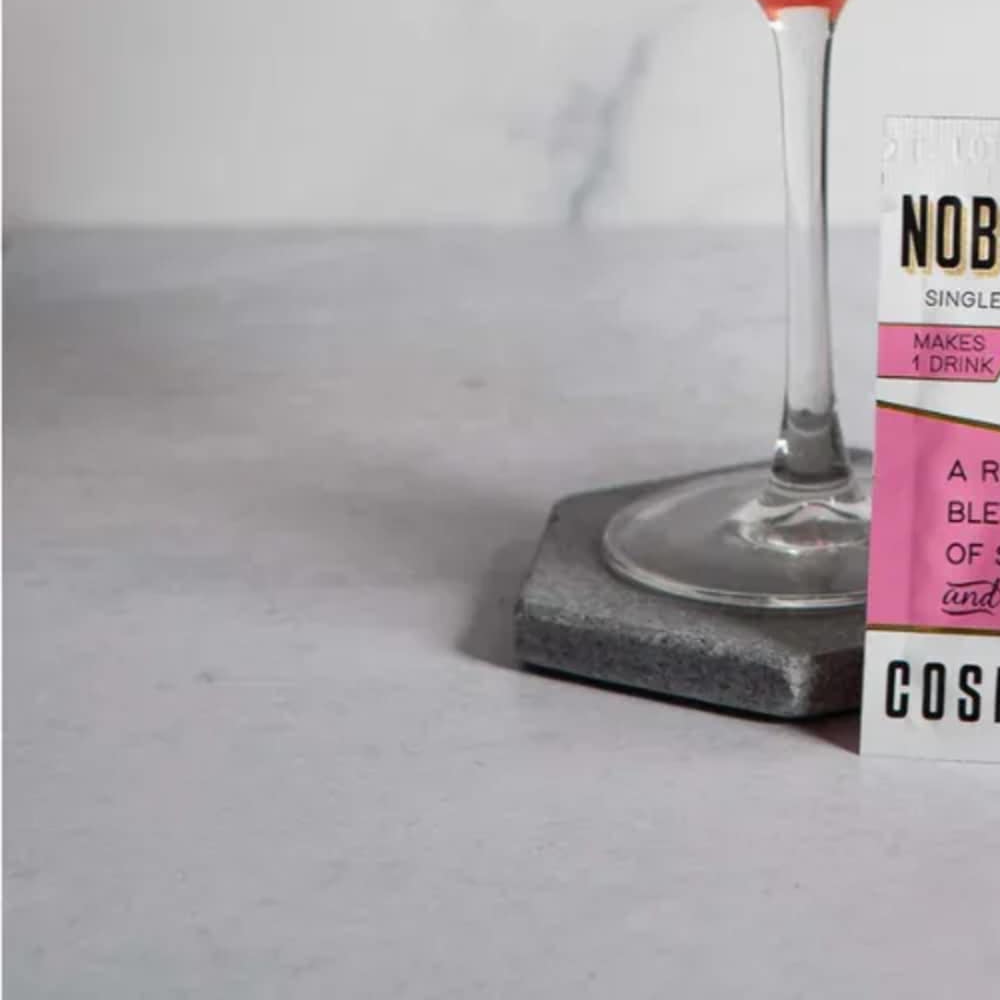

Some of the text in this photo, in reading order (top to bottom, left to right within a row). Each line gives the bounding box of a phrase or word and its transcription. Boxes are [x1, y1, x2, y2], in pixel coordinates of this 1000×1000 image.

[912, 333, 986, 352] MAKES
[911, 355, 995, 375] 1 DRINK
[947, 460, 967, 482] A
[945, 543, 984, 565] OF
[941, 577, 1000, 616] and
